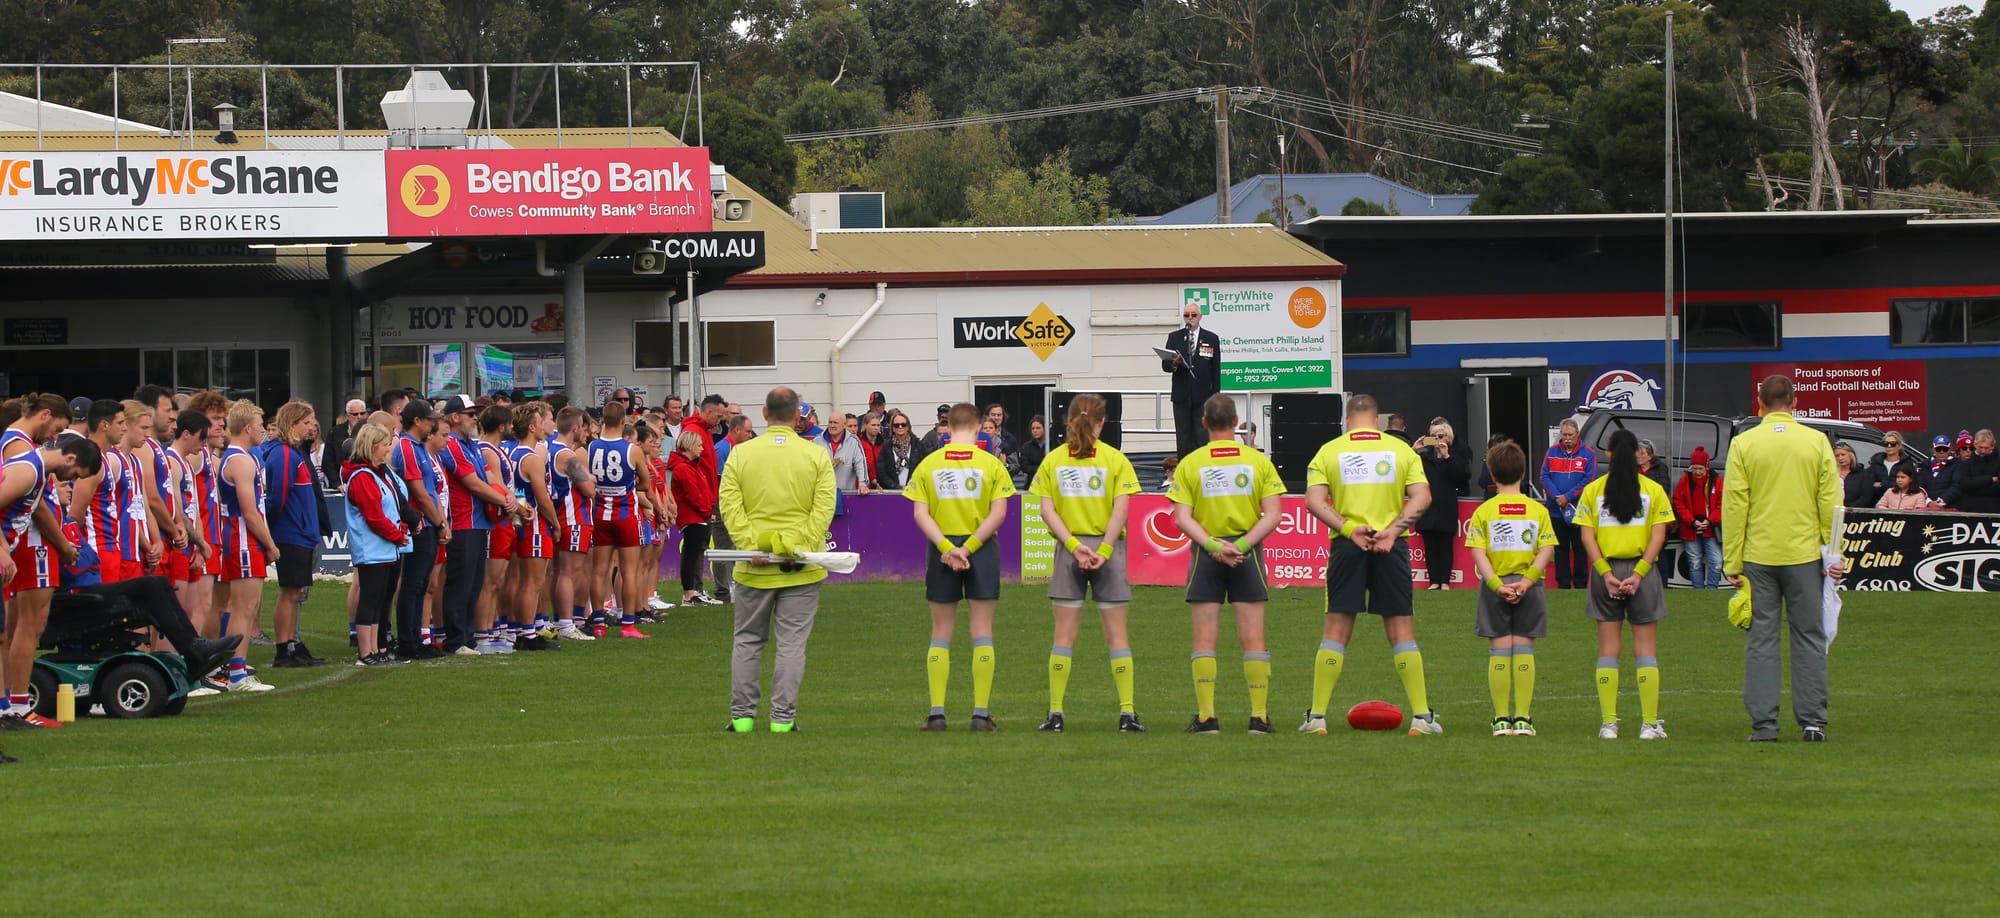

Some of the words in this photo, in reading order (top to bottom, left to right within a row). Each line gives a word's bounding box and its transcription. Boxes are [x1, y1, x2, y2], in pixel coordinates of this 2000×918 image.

[467, 163, 601, 199] Bendigo
[608, 161, 693, 193] Bank
[469, 205, 514, 218] Cowes
[518, 204, 597, 220] Community
[649, 203, 696, 217] Branch
[36, 214, 164, 238] INSURANCE
[180, 213, 282, 237] BROKERS
[1212, 290, 1274, 305] TerryWhite
[1212, 301, 1271, 312] Chemmart
[408, 306, 457, 329] HOT
[465, 305, 530, 329] FOOD
[1233, 337, 1275, 346] Chemmart
[1276, 336, 1300, 346] Phillip
[1301, 336, 1325, 345] Island
[1221, 368, 1243, 377] mpson
[1245, 367, 1270, 375] Avenue,
[1271, 366, 1294, 374] Cowes
[1294, 365, 1307, 373] VIC
[1307, 365, 1325, 373] 3922
[1795, 368, 1823, 378] Proud
[1826, 369, 1869, 379] sponsors
[1872, 366, 1882, 377] of
[1244, 375, 1260, 383] 5952
[1792, 382, 1818, 392] sland
[1821, 381, 1860, 391] Football
[1862, 380, 1896, 390] Netball
[1898, 379, 1920, 390] Club
[1808, 408, 1832, 418] Bank
[592, 448, 624, 483] 48
[1024, 502, 1041, 510] Par
[1024, 514, 1043, 522] Sch
[1024, 526, 1048, 536] Corp
[1263, 547, 1311, 562] mpson
[1859, 551, 1904, 569] Club
[1274, 565, 1313, 579] 5952
